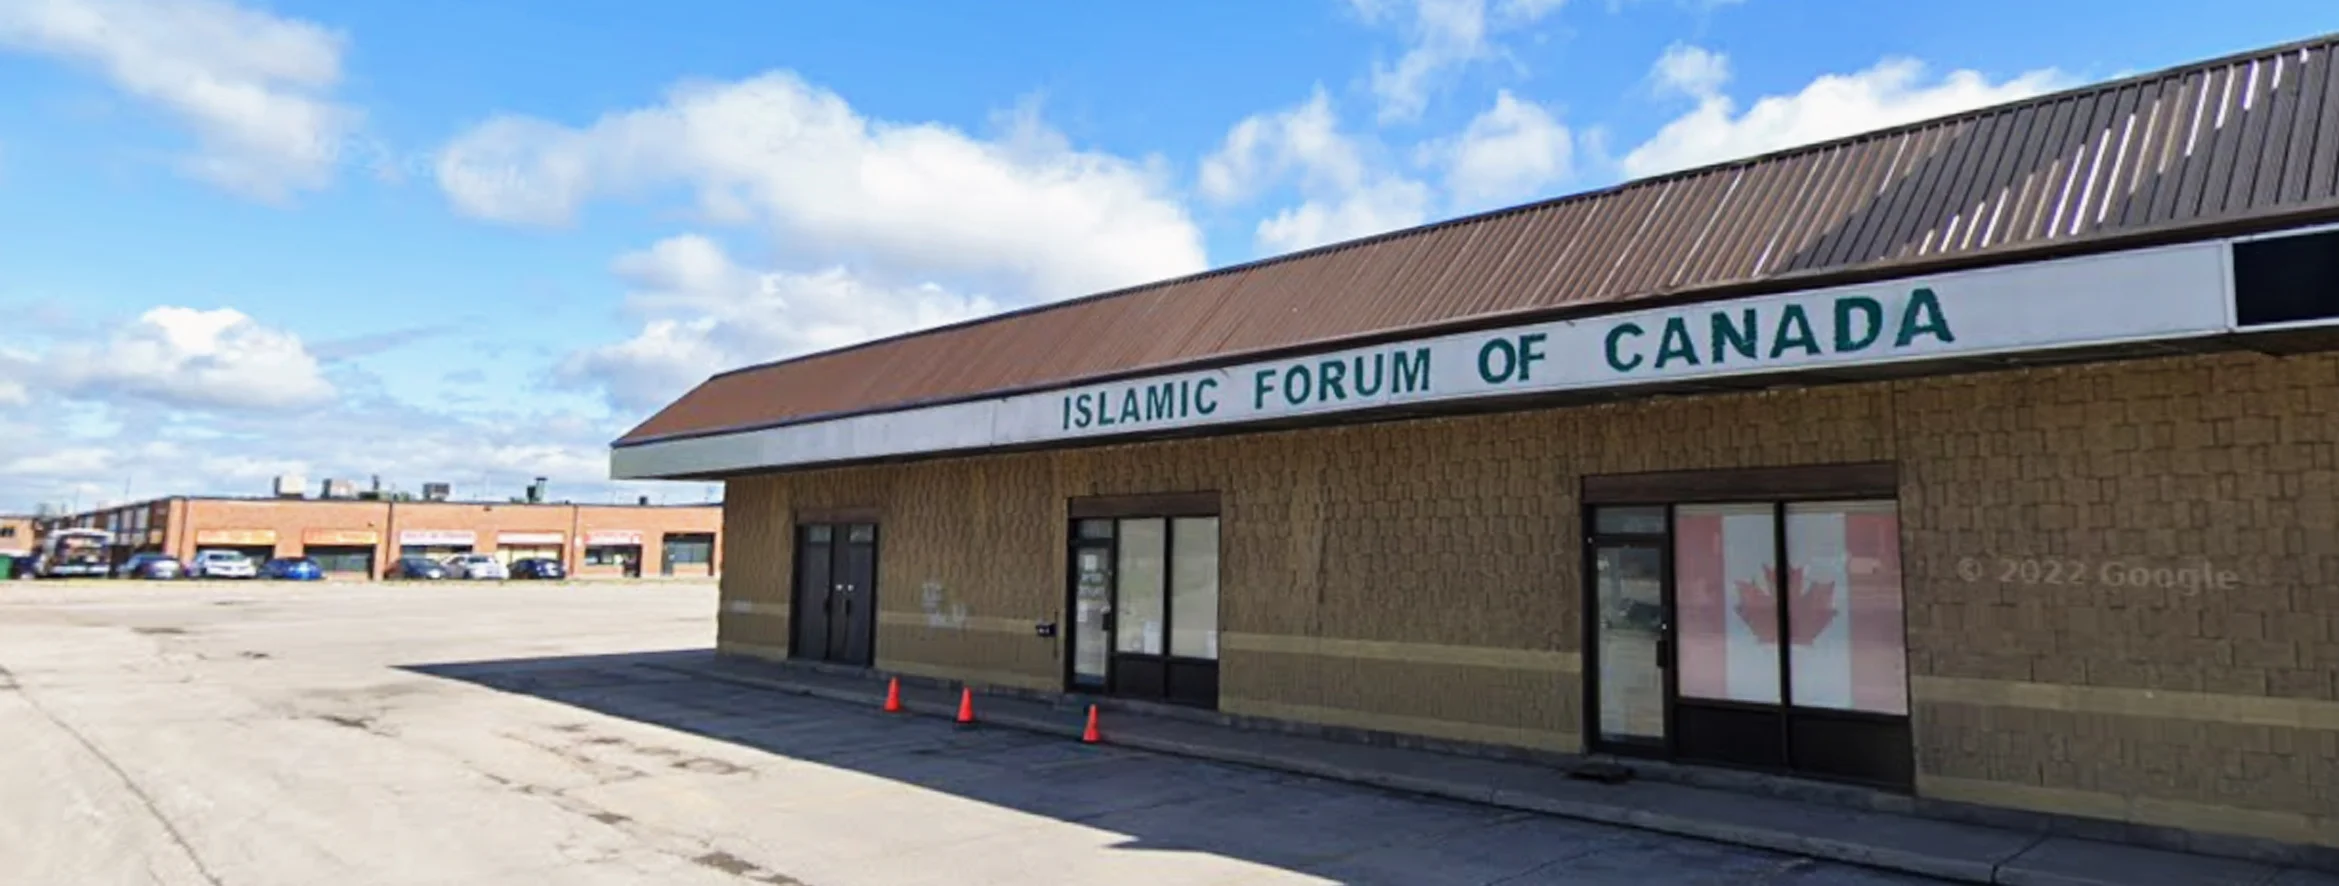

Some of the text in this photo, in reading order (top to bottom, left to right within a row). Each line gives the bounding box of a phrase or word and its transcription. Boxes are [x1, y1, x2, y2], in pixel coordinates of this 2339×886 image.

[1062, 287, 1957, 430] ISLAMIC FORUM OF CANADA
